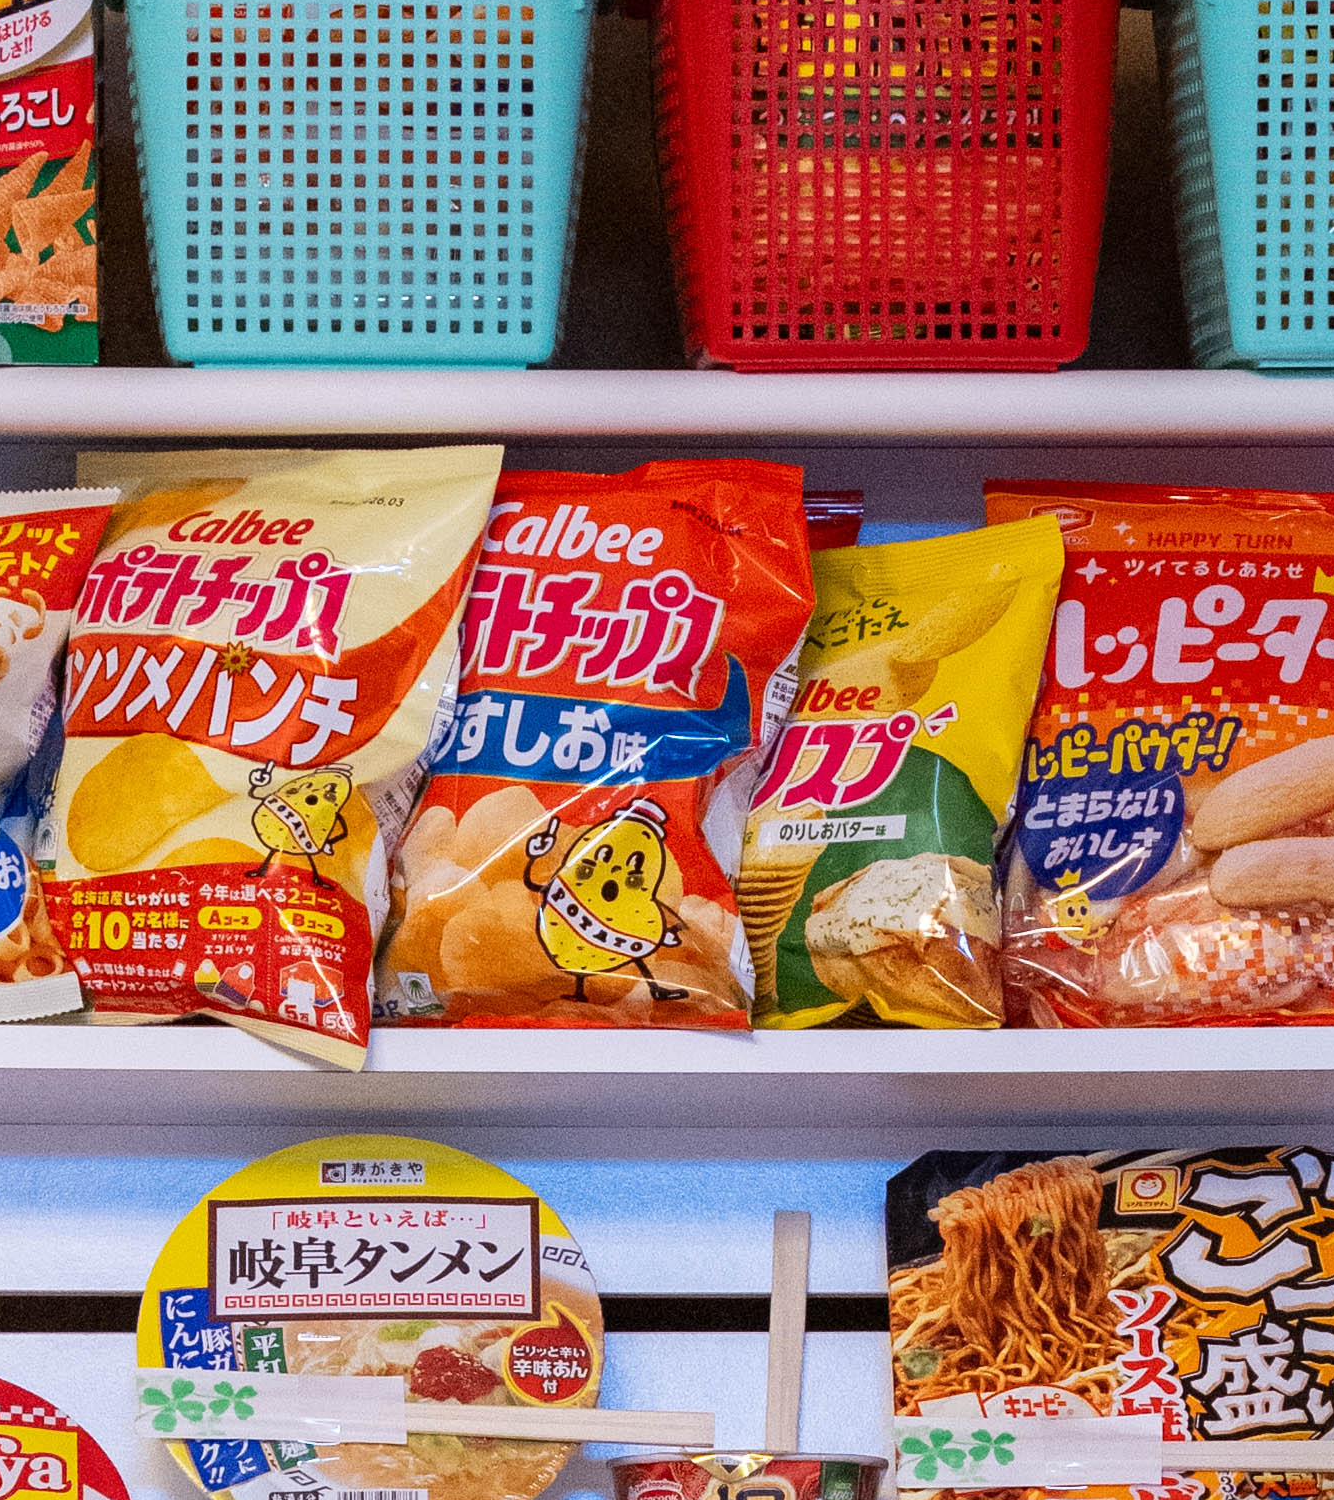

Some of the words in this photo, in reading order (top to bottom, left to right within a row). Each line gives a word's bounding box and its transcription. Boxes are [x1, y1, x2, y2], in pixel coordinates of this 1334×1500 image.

[168, 510, 315, 547] Calbee
[481, 501, 663, 565] Calbee
[1148, 531, 1221, 549] HAPPY
[1233, 532, 1292, 550] TURN
[1125, 557, 1304, 580] ツイてるしあわせ
[75, 546, 354, 648] ポテトチップス
[1025, 788, 1175, 829] とまらない
[268, 796, 315, 854] POTATO
[780, 823, 886, 841] のりしおバター味
[1044, 826, 1163, 869] おいしさ
[72, 891, 190, 906] 北海道産じゃがいも
[199, 884, 343, 912] 今年は選べる2コース
[208, 910, 250, 926] Aコース
[292, 912, 333, 933] Bコース
[550, 886, 648, 956] POTATO
[87, 911, 130, 949] 10
[132, 912, 189, 929] 万名様に
[132, 932, 185, 949] 当たる!
[205, 944, 255, 955] エコバッグ
[351, 1161, 423, 1176] 寿がきや
[229, 1237, 524, 1290] 岐阜タンメン
[513, 1345, 586, 1358] ピリッと辛い
[513, 1360, 588, 1378] 辛味あん
[543, 1380, 558, 1394] 付
[1003, 1393, 1068, 1416] キューピー
